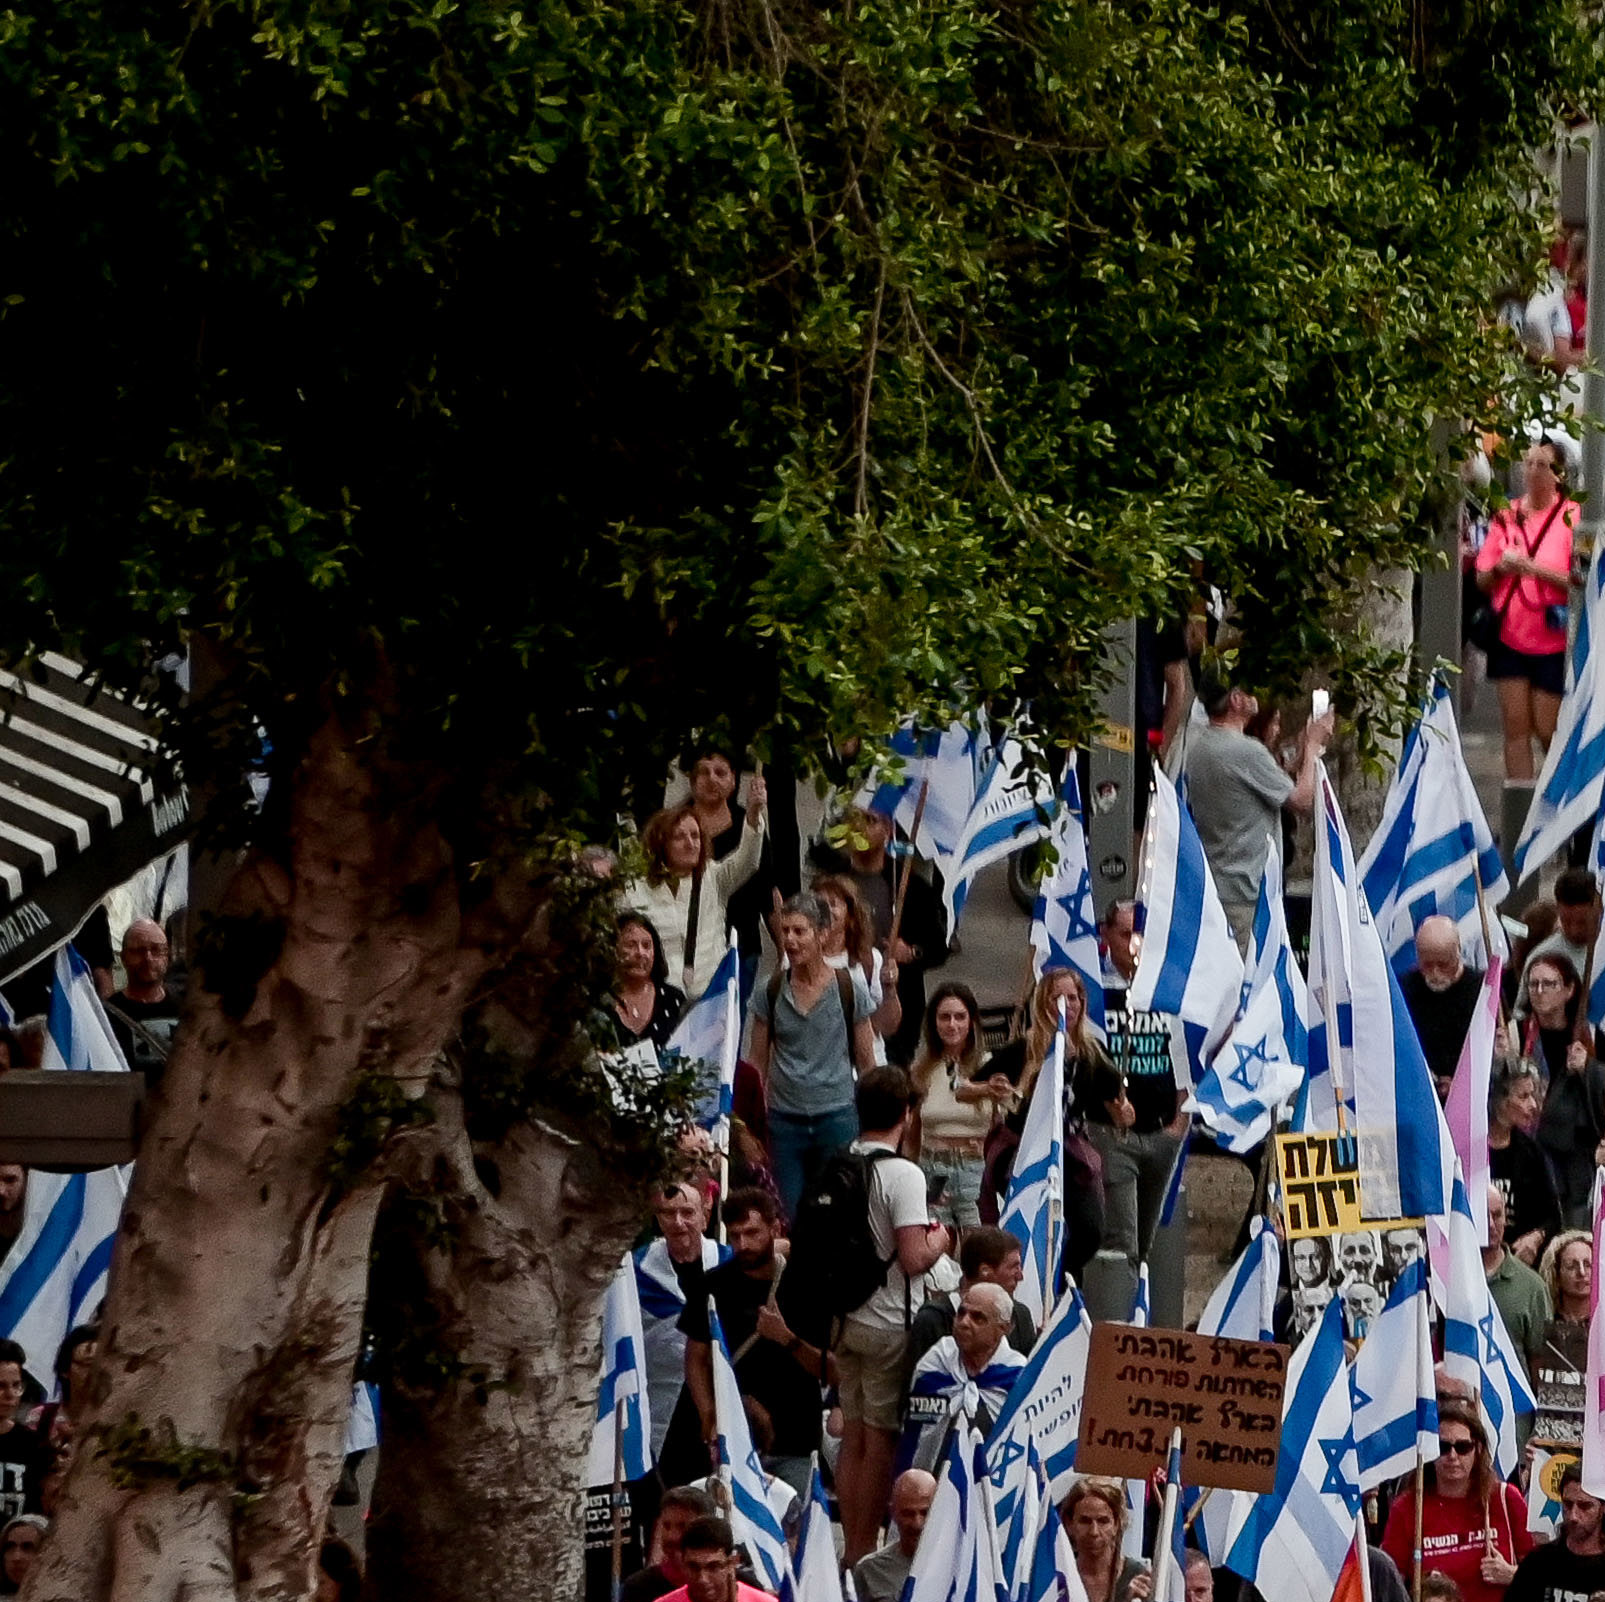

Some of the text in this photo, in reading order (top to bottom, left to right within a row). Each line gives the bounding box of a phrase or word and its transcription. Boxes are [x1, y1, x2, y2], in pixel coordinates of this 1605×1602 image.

[1114, 1334, 1283, 1372] בארץ אהבתי
[1024, 1375, 1073, 1423] להיות
[1038, 1397, 1083, 1438] ופשי
[1127, 1395, 1276, 1432] בארץ אהבתי
